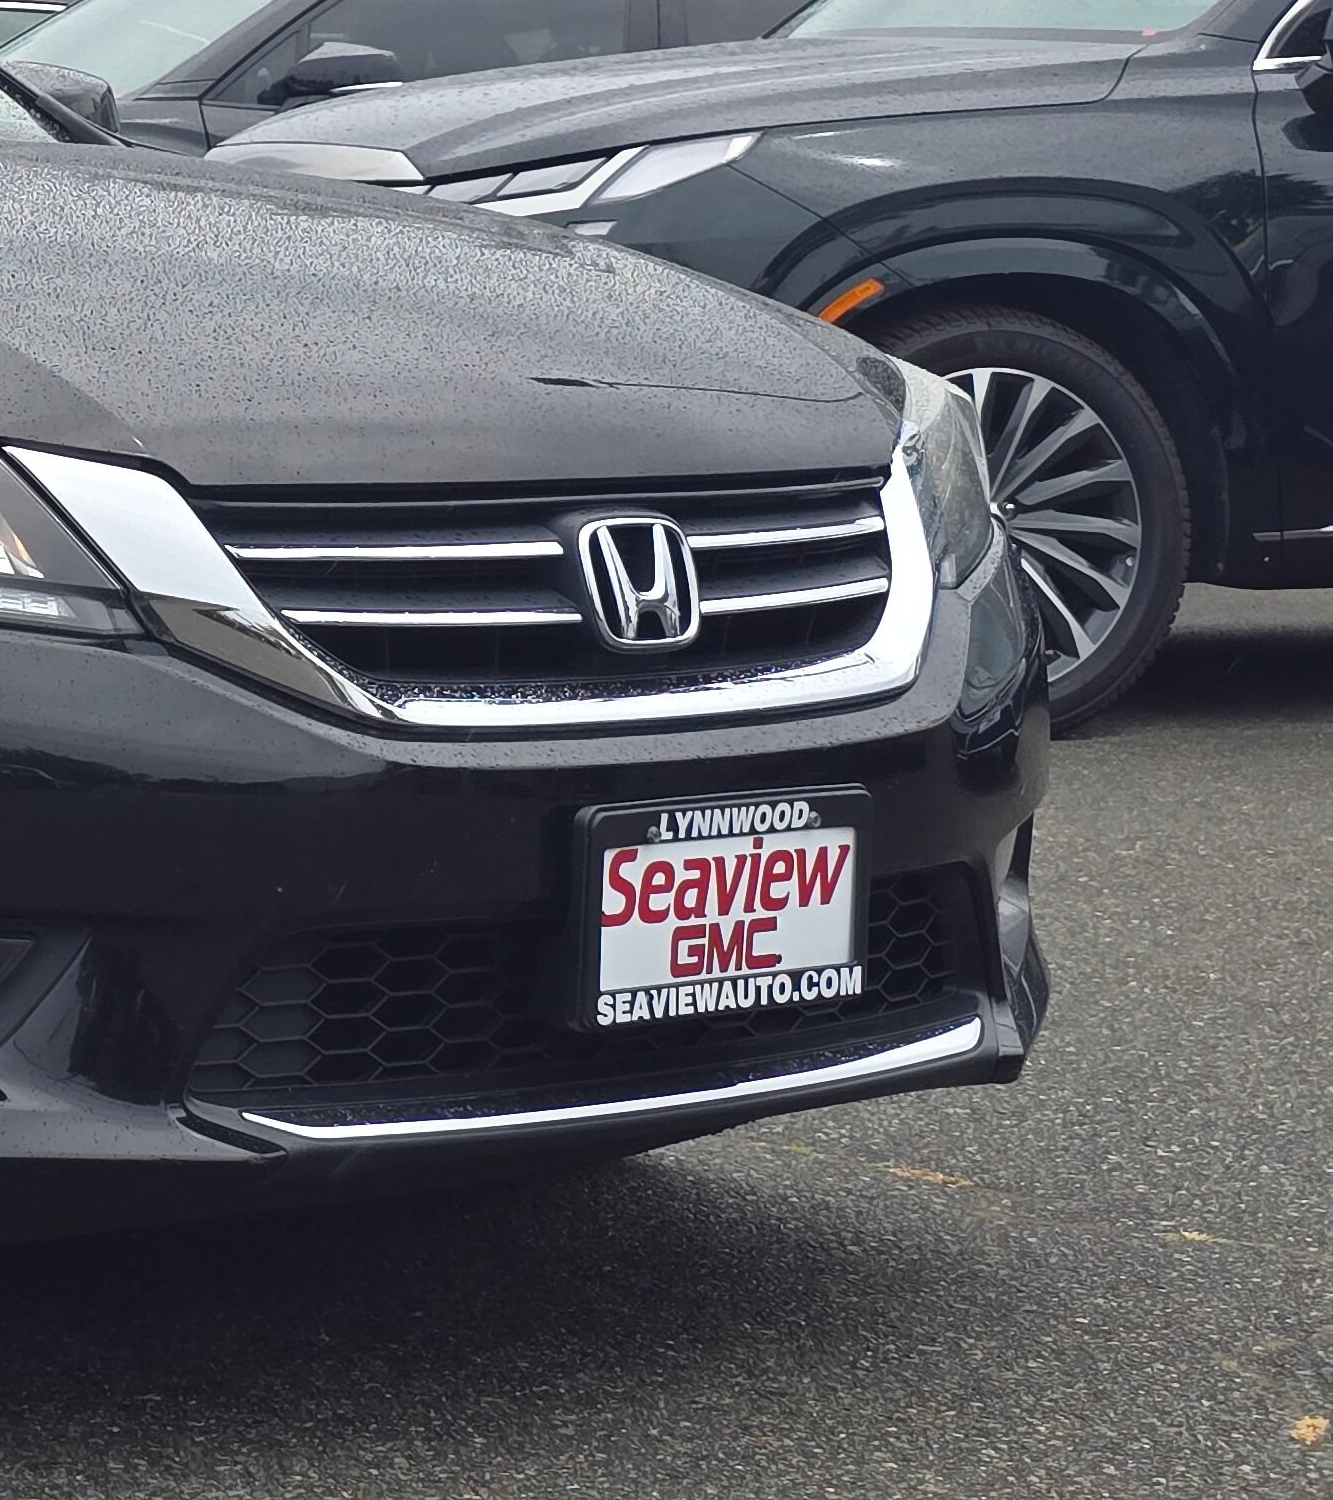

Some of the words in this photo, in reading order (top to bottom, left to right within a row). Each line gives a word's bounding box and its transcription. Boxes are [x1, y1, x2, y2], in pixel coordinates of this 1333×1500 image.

[659, 800, 810, 841] LYNNWOOD
[599, 836, 851, 928] Seaview
[670, 916, 780, 979] GMC
[596, 965, 863, 1027] SEAVIEWAUTO.COM
